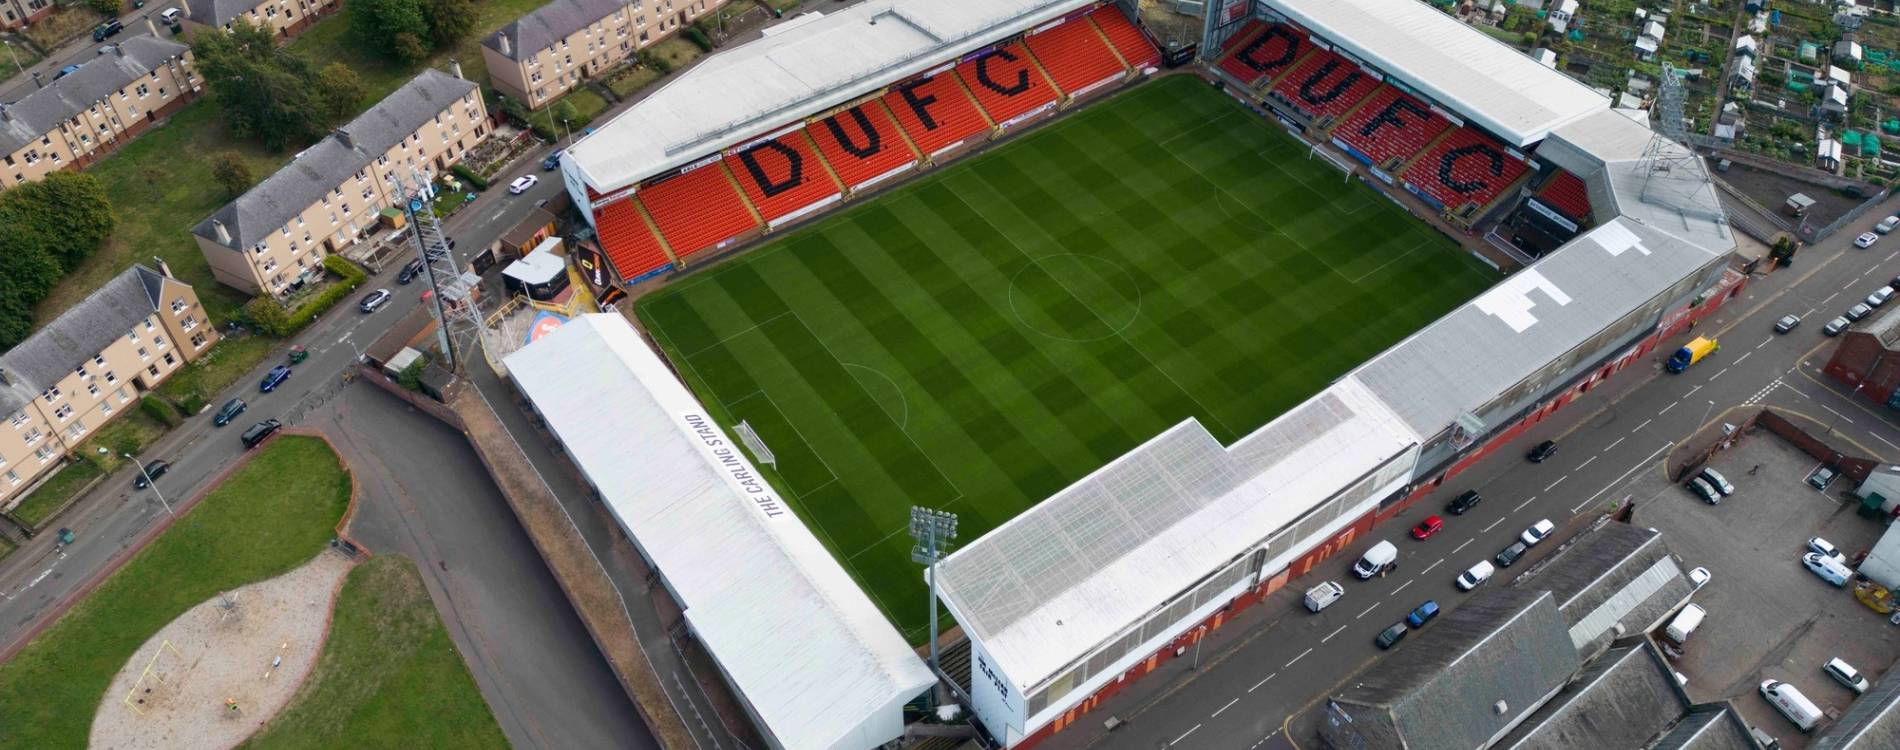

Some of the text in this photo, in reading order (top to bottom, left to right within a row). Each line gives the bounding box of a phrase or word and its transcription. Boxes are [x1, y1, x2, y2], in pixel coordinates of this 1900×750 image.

[684, 414, 784, 518] THE CARLING STAND
